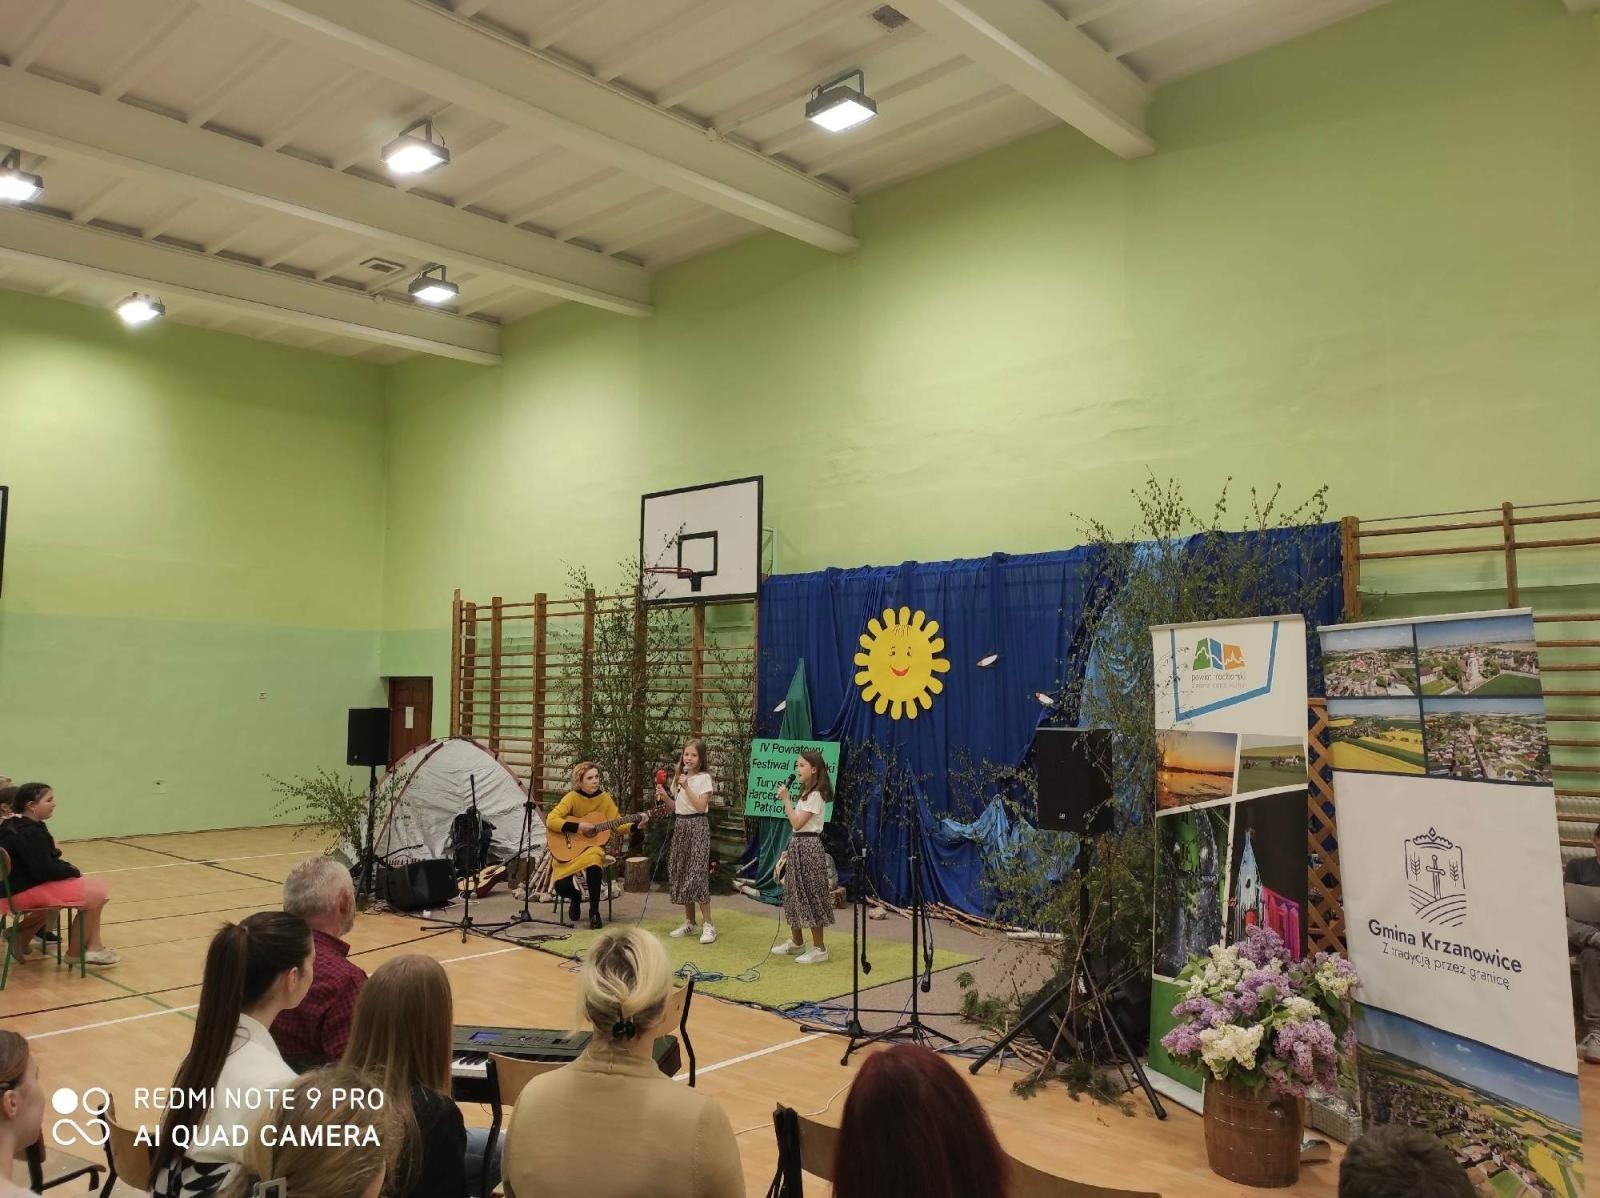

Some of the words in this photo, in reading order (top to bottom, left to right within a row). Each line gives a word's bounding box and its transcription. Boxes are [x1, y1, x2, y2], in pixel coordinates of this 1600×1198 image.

[760, 742, 770, 753] IV
[752, 758, 790, 771] Festiwal
[1368, 919, 1416, 945] Gmina
[1421, 931, 1522, 973] Krzanowice
[1382, 942, 1389, 954] Z
[1391, 947, 1431, 969] tradycją
[1434, 958, 1467, 975] przez
[1469, 967, 1511, 991] granicę
